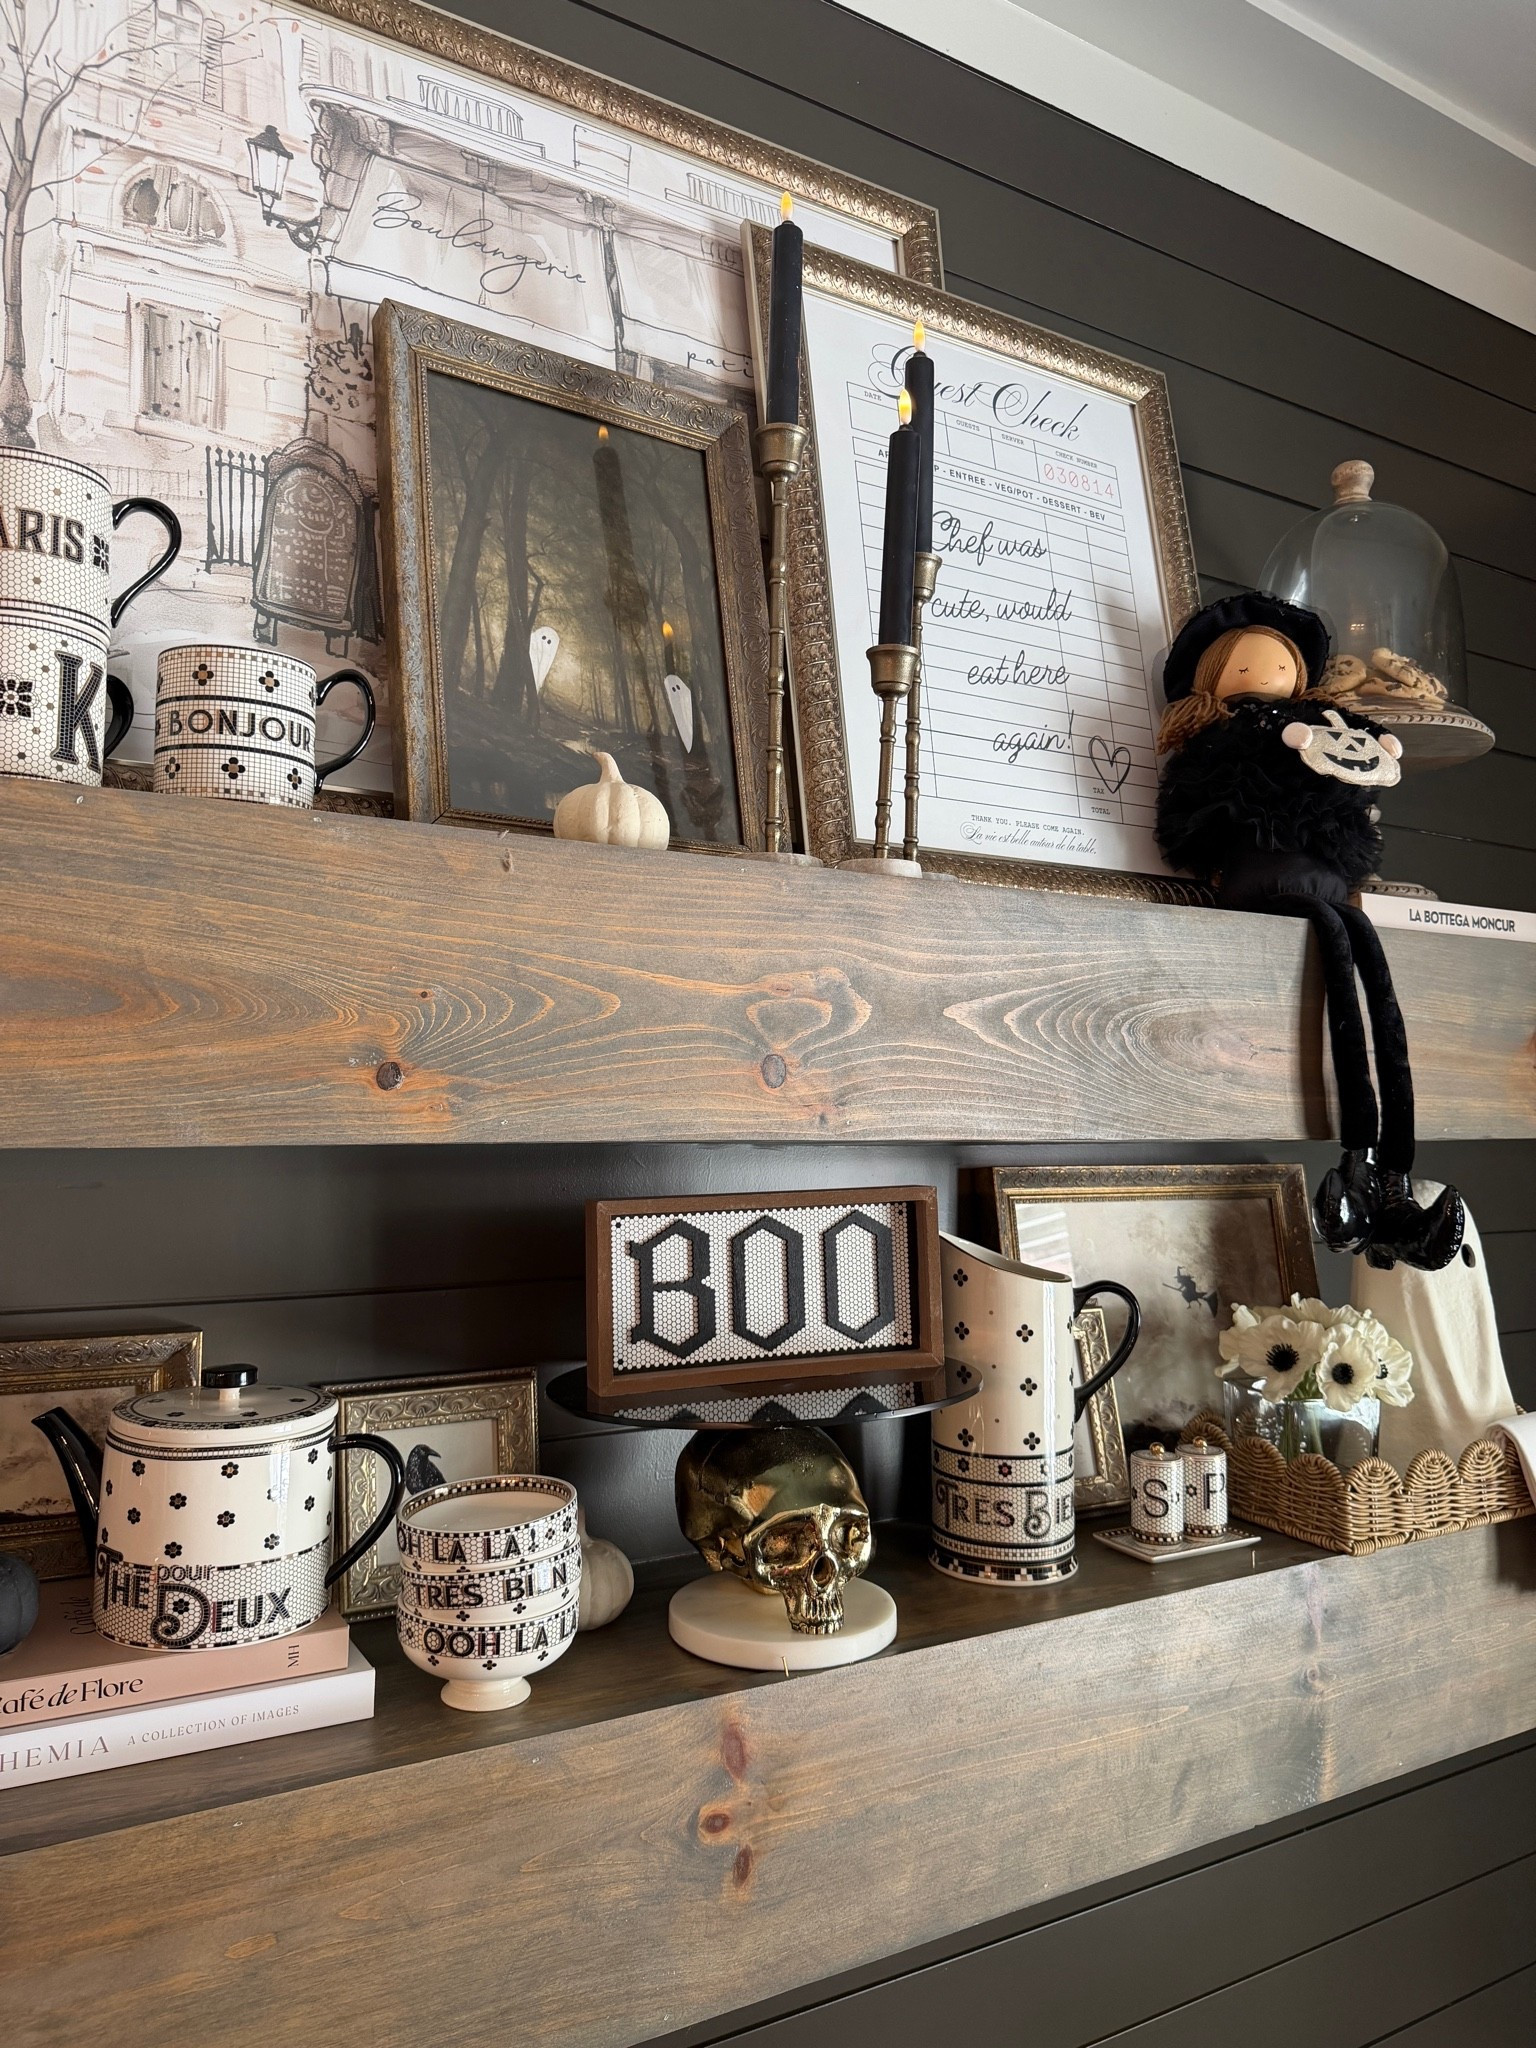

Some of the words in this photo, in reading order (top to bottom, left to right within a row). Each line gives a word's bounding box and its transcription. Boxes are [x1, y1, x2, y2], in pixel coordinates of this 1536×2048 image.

[372, 192, 586, 294] Boulangerie
[863, 391, 882, 402] DATE
[974, 383, 1089, 442] Check
[955, 419, 981, 432] GUESTS
[1001, 433, 1025, 446] SERVER
[1055, 450, 1074, 463] CHECK
[1076, 457, 1098, 470] NUMBER
[949, 469, 986, 487] ENTREE
[995, 481, 1034, 501] VEG/POT
[1042, 496, 1081, 515] DESSERT
[1089, 510, 1106, 522] BEV
[1043, 463, 1115, 499] 030814
[931, 510, 994, 567] Chef
[998, 538, 1047, 558] was
[931, 589, 991, 622] cute,
[997, 588, 1073, 622] would
[967, 655, 1007, 685] eat
[1013, 650, 1070, 685] here
[169, 708, 312, 753] BONJOUR
[993, 709, 1075, 764] again!
[1092, 787, 1105, 795] TAX
[971, 814, 992, 824] THANK
[1015, 820, 1040, 830] PLEASE
[1042, 824, 1060, 833] COME
[1091, 806, 1111, 816] TOTAL
[1409, 908, 1422, 923] LA
[1424, 910, 1470, 928] BOTTEGA
[1471, 916, 1516, 933] MONCUR
[629, 1209, 896, 1360] BOO
[1143, 1479, 1169, 1518] S
[1204, 1473, 1225, 1511] P
[432, 1536, 468, 1562] LA
[157, 1563, 216, 1585] pour
[503, 1562, 567, 1602] BIN
[150, 1583, 291, 1648] DEUX
[287, 1644, 299, 1668] MH
[423, 1627, 500, 1658] OOH
[515, 1624, 549, 1653] LA
[0, 1688, 45, 1715] afé
[48, 1682, 78, 1708] de
[80, 1678, 144, 1702] Flore
[127, 1735, 136, 1746] A
[142, 1717, 227, 1744] COLLECTION
[231, 1713, 249, 1727] OF
[252, 1703, 300, 1724] IMAGES
